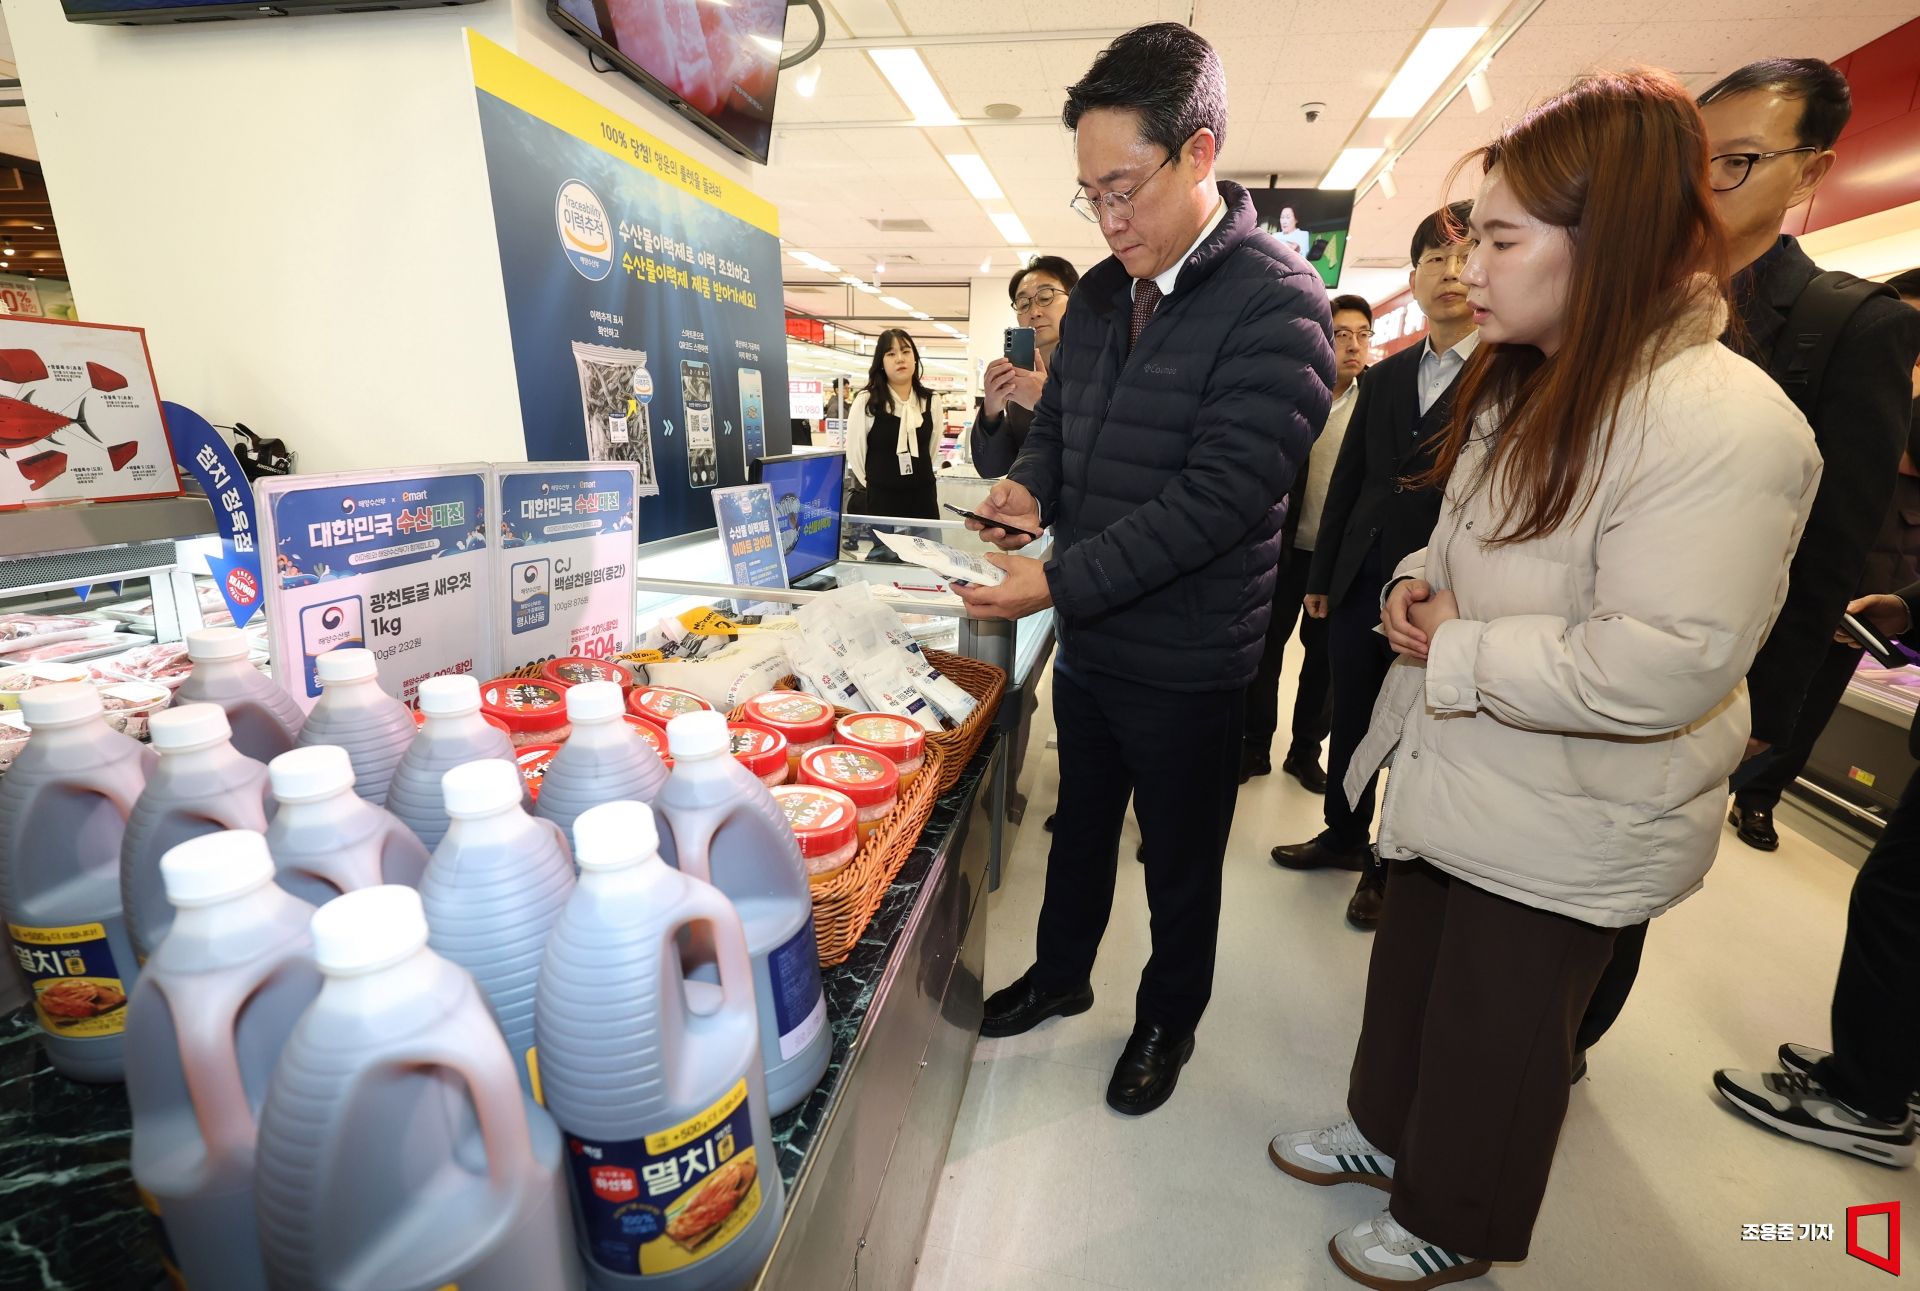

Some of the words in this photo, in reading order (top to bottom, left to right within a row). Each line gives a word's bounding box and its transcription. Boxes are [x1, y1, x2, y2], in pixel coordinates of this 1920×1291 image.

[601, 122, 628, 149] 100%
[631, 138, 652, 164] 당첨!
[563, 194, 602, 220] Traceability
[564, 209, 605, 241] 이력추적
[619, 220, 696, 265] 수산물이력제로
[697, 250, 717, 276] 이력
[622, 251, 689, 290] 수산물이력제
[691, 275, 711, 299] 제품
[196, 443, 232, 489] 참치
[221, 487, 254, 553] 정육점
[402, 490, 428, 502] emart
[520, 496, 573, 519] 대한민국
[575, 491, 620, 515] 수산대전
[308, 512, 394, 548] 대한민국
[396, 501, 465, 535] 수산대전
[554, 557, 572, 574] CJ
[554, 563, 626, 592] 백설천일염(중간)
[228, 575, 256, 599] SEAFOOD
[370, 581, 430, 614] 광천토굴
[433, 572, 472, 599] 새우젓
[318, 631, 351, 645] 해양수산부
[370, 616, 402, 637] 1kg
[398, 637, 422, 654] 232원
[14, 944, 65, 977] 멸치
[641, 1138, 716, 1197] 멸치
